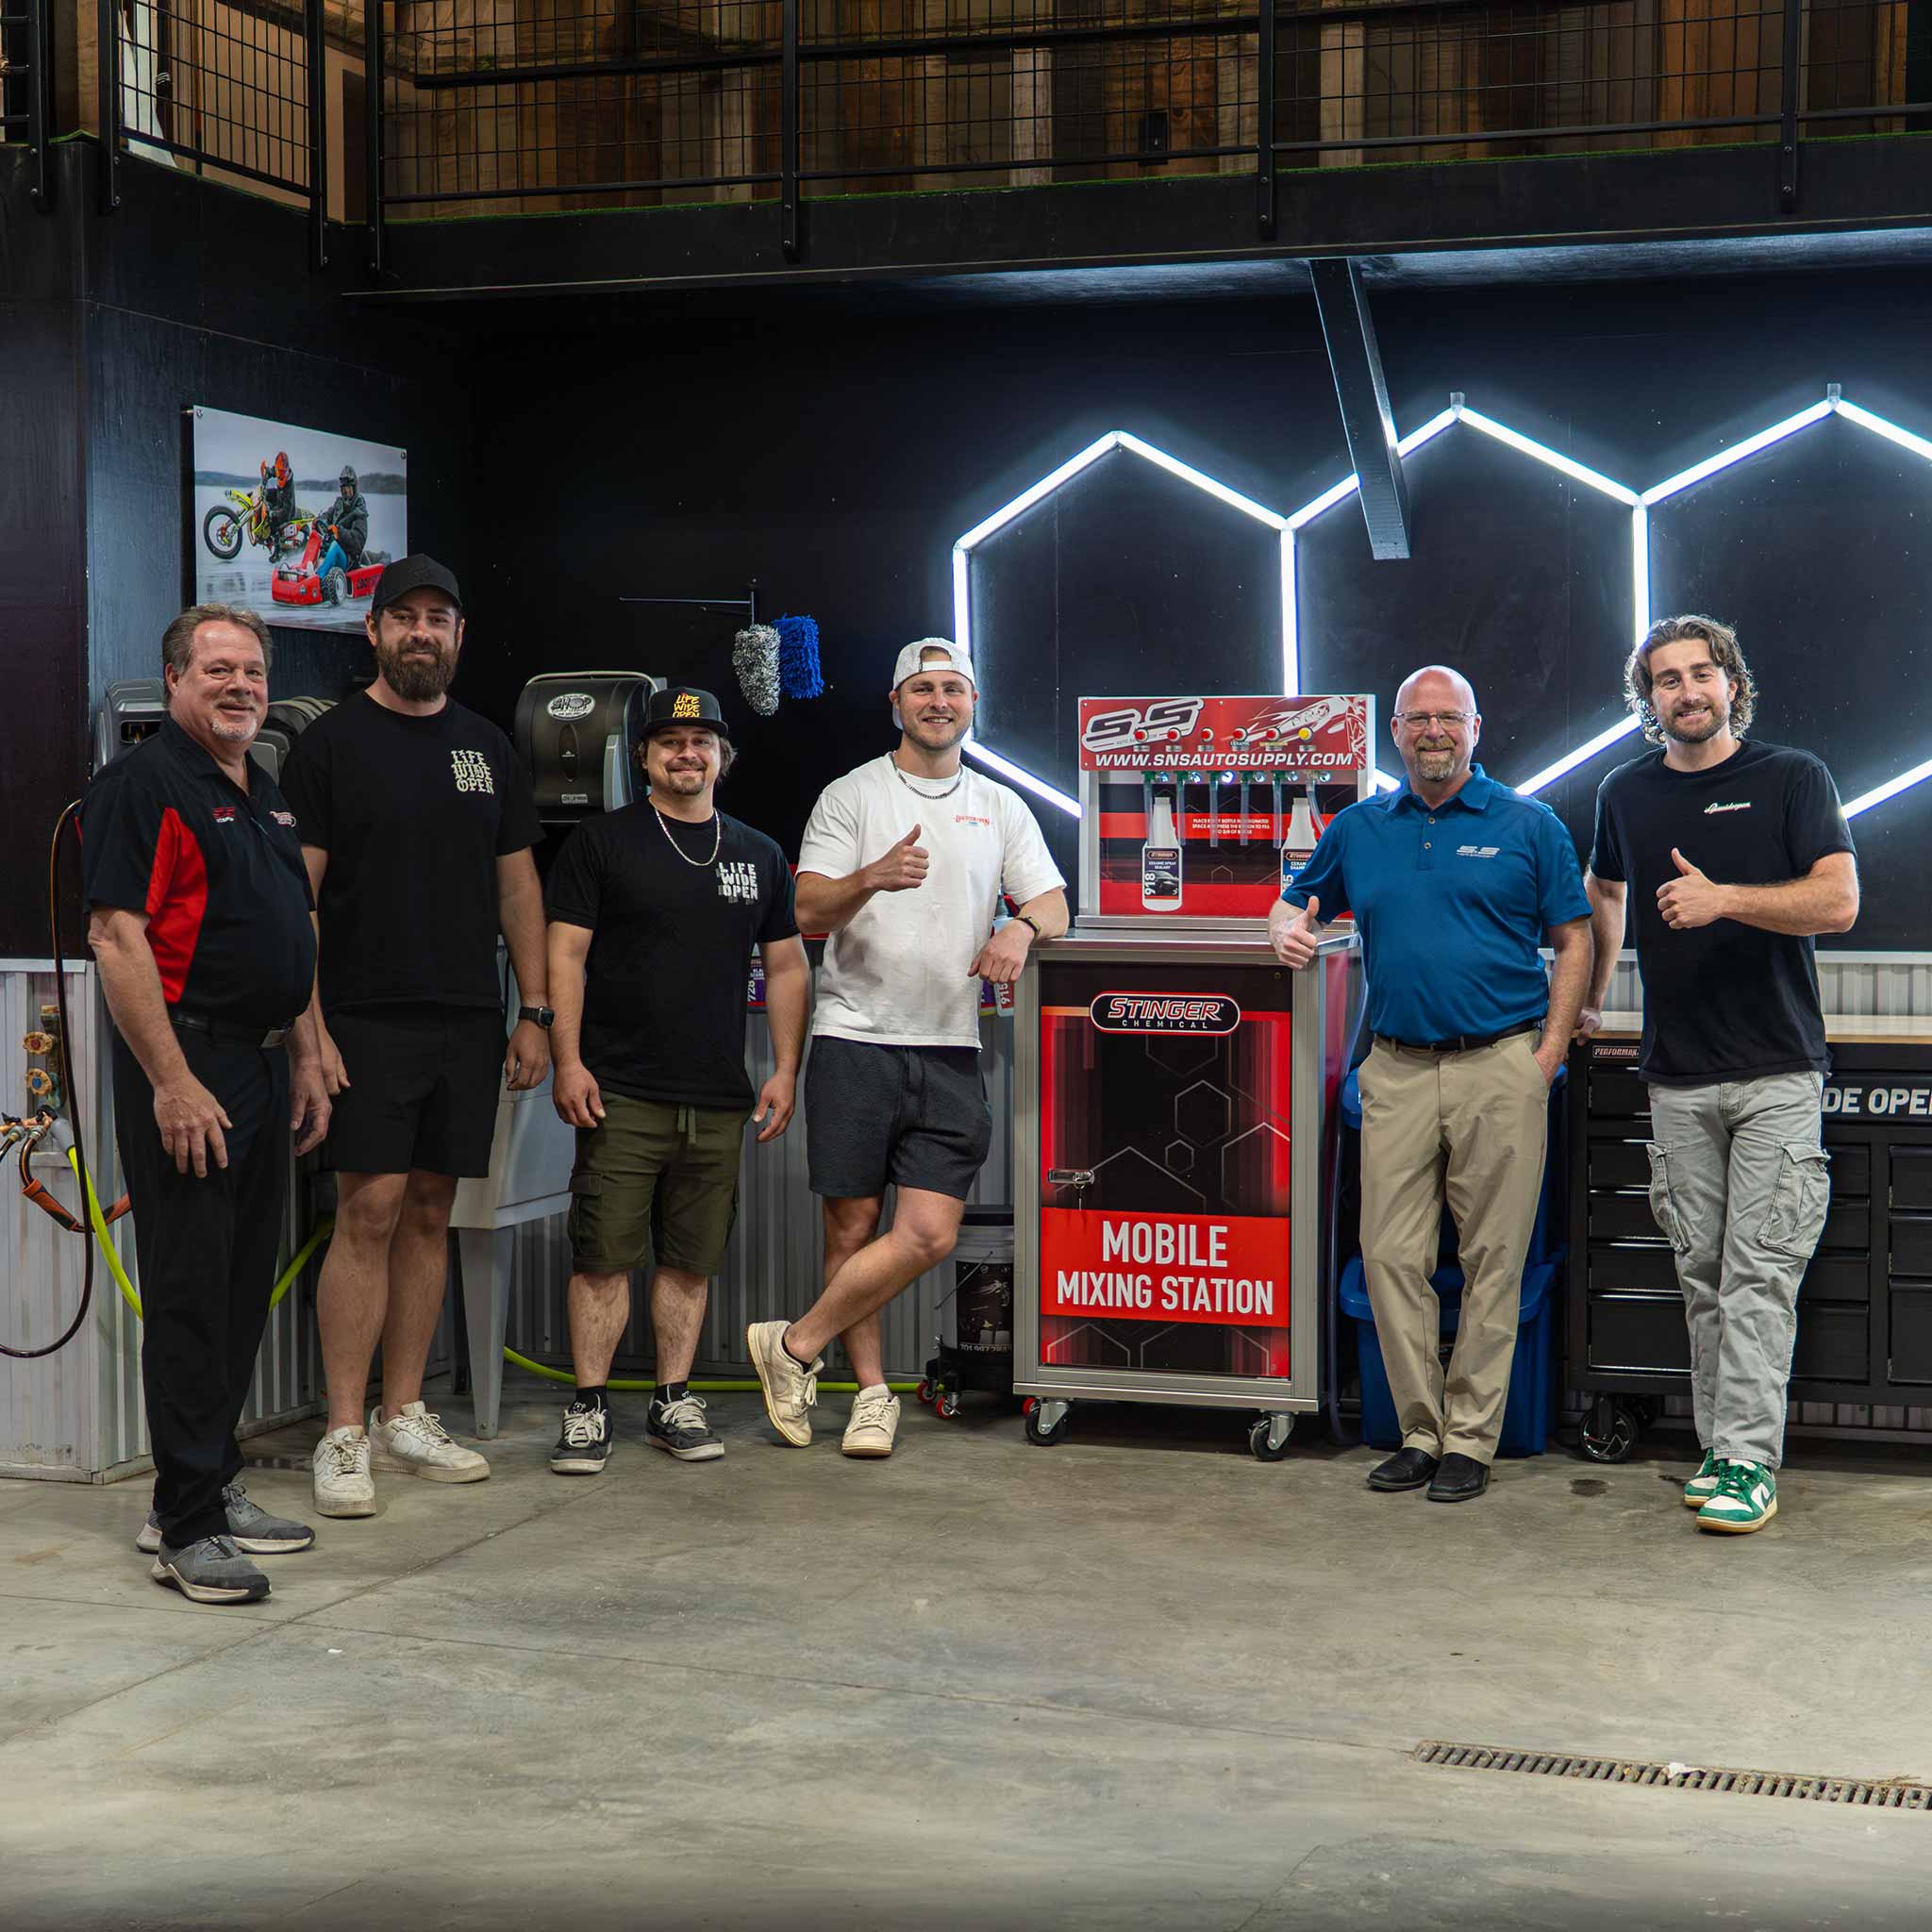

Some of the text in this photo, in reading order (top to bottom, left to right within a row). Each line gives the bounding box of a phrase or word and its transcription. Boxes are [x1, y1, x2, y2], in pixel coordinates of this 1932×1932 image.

[676, 694, 700, 704] LIFE
[674, 704, 700, 712] WIDE
[1095, 753, 1353, 768] WWW.SNSAUTOSUPPLY.COM
[451, 763, 492, 780] WIDE
[457, 777, 494, 795] OPEN
[719, 861, 756, 875] LIFE
[720, 873, 758, 887] WIDE
[1144, 873, 1156, 895] 918
[723, 884, 758, 900] OPEN
[1108, 997, 1222, 1021] STINGER
[1122, 1019, 1208, 1029] CHEMICAL
[1868, 1088, 1932, 1115] OPE
[1102, 1221, 1228, 1268] MOBILE
[1057, 1270, 1274, 1315] MIXING STATION
